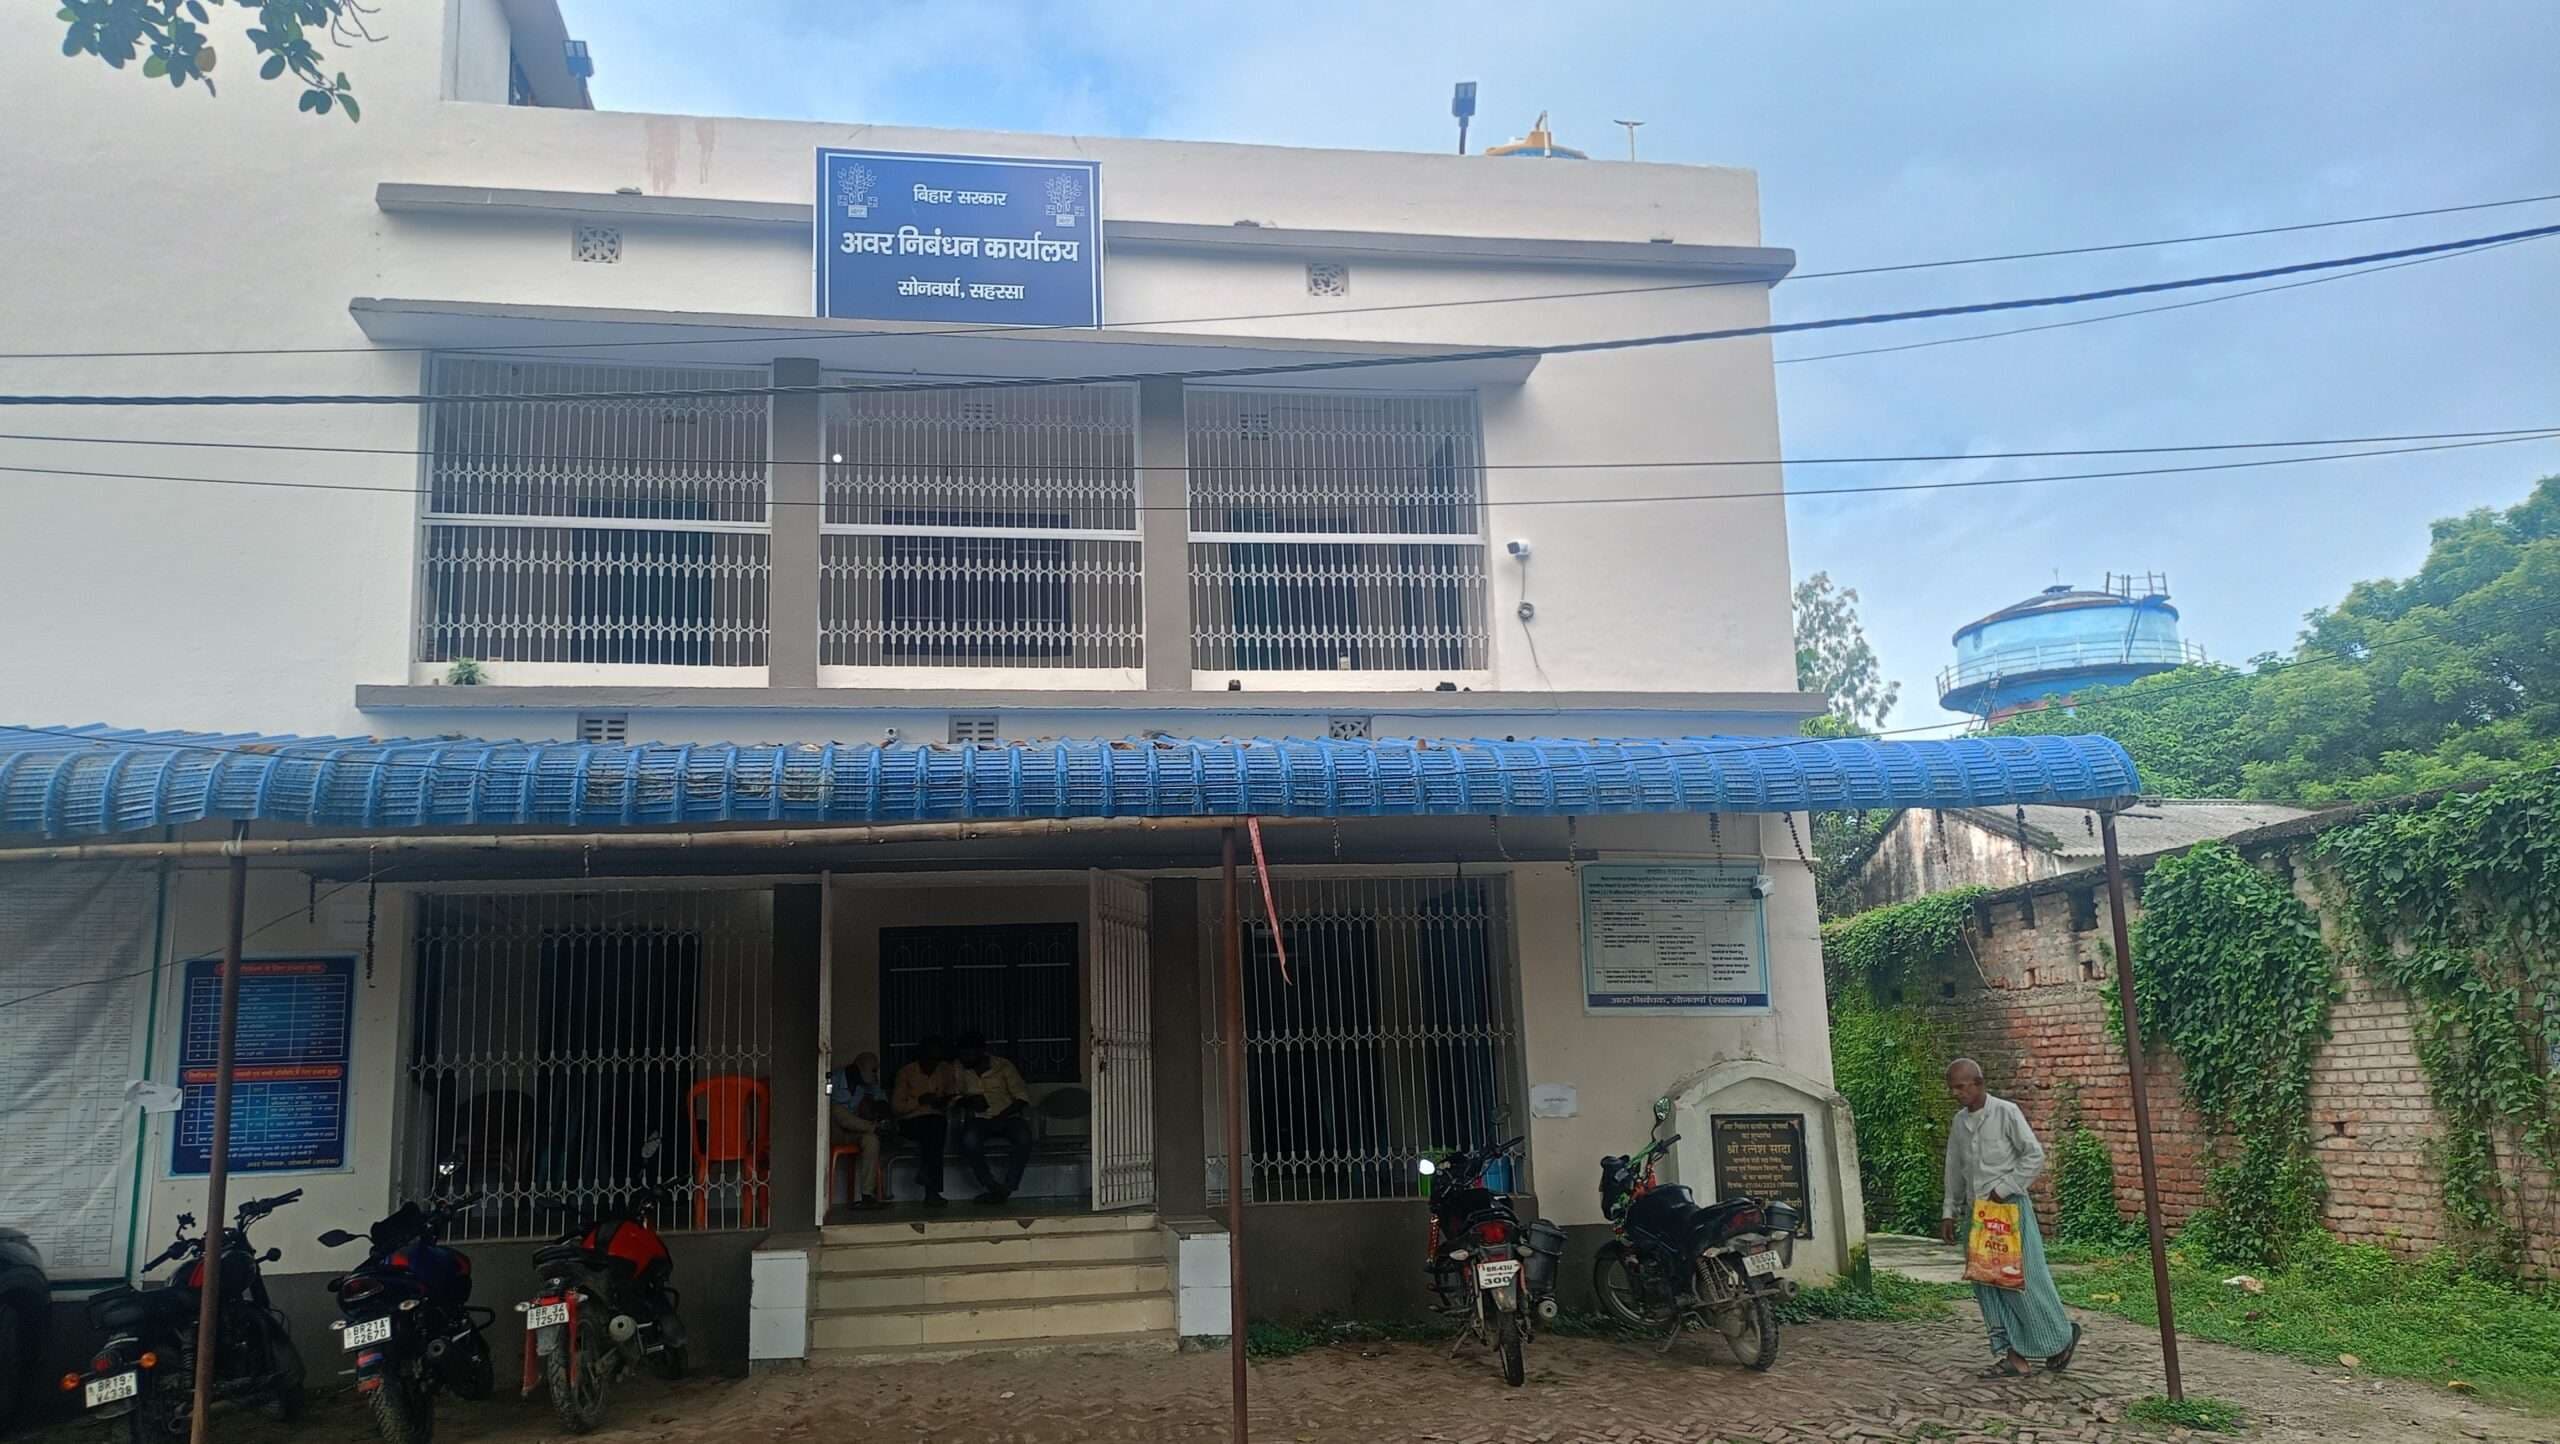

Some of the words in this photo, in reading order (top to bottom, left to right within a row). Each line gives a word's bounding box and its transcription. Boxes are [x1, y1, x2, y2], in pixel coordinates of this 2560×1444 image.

[912, 183, 953, 204] बिहार
[957, 190, 1007, 205] सरकार
[841, 231, 894, 255] अवर
[898, 225, 979, 258] निबंधन
[984, 232, 1080, 262] कार्यालय
[897, 276, 965, 299] सोनवर्षा,
[969, 283, 1025, 300] सहरसा
[1727, 1141, 1739, 1154] श्री
[1984, 1239, 2009, 1253] Atta
[535, 1307, 547, 1317] BR
[353, 1319, 385, 1336] BR21A
[353, 1328, 386, 1344] G2670
[97, 1375, 126, 1392] BR19
